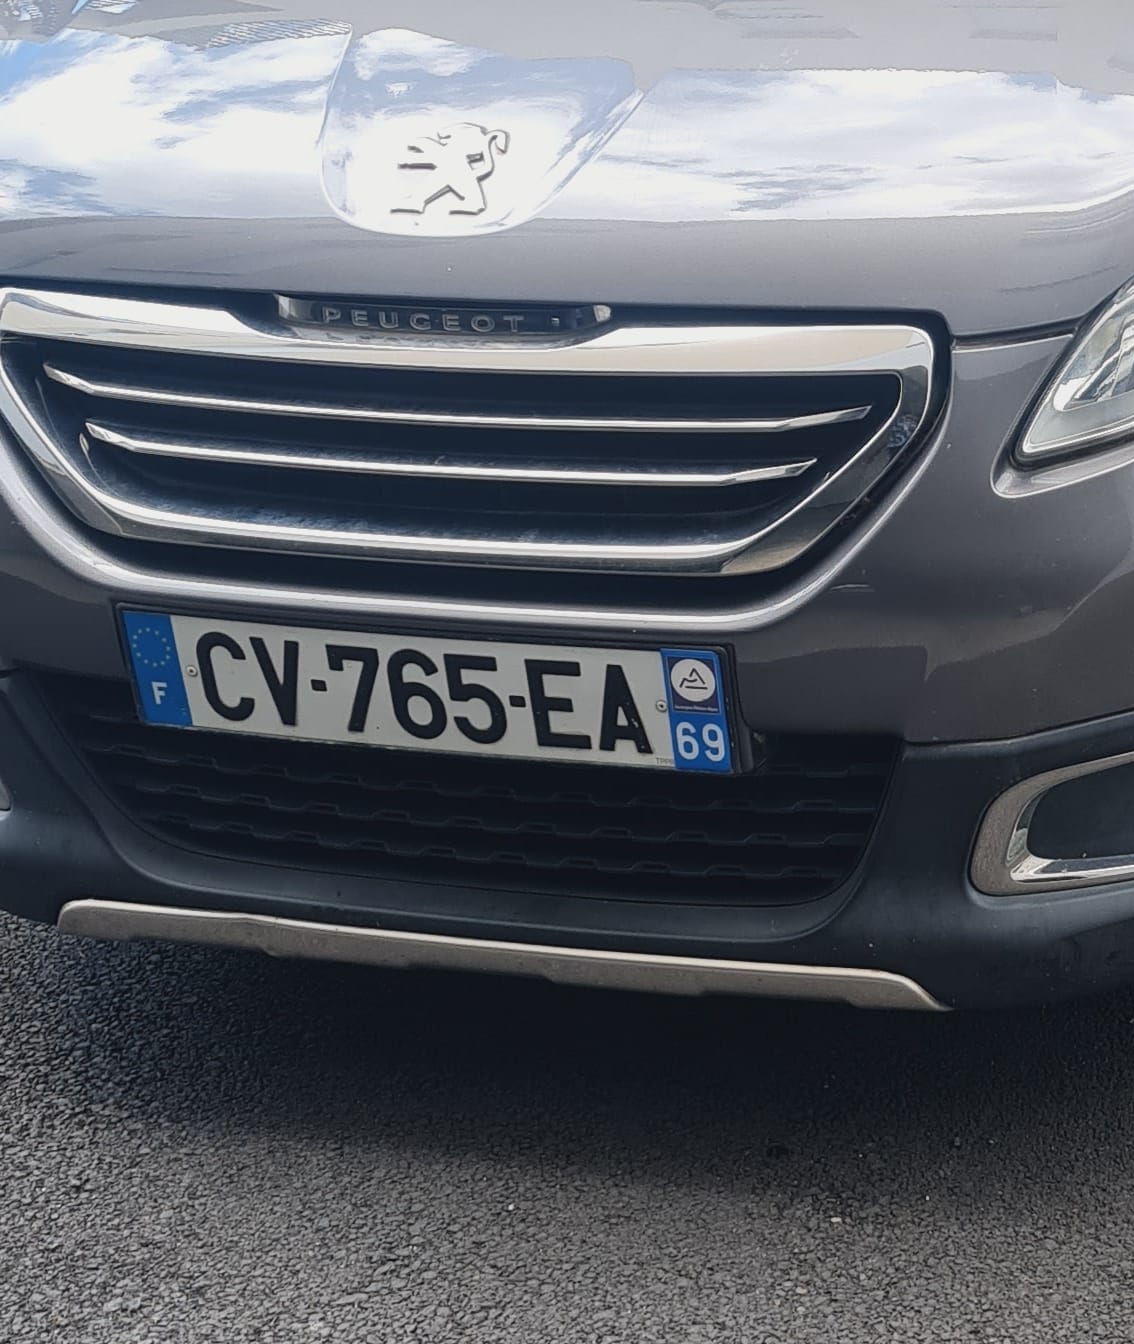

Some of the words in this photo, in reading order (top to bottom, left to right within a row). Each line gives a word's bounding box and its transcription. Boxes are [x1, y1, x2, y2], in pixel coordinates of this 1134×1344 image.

[322, 306, 525, 333] PEUGEOT
[151, 681, 168, 707] F
[195, 630, 654, 755] CV-765-EA
[675, 721, 726, 762] 69
